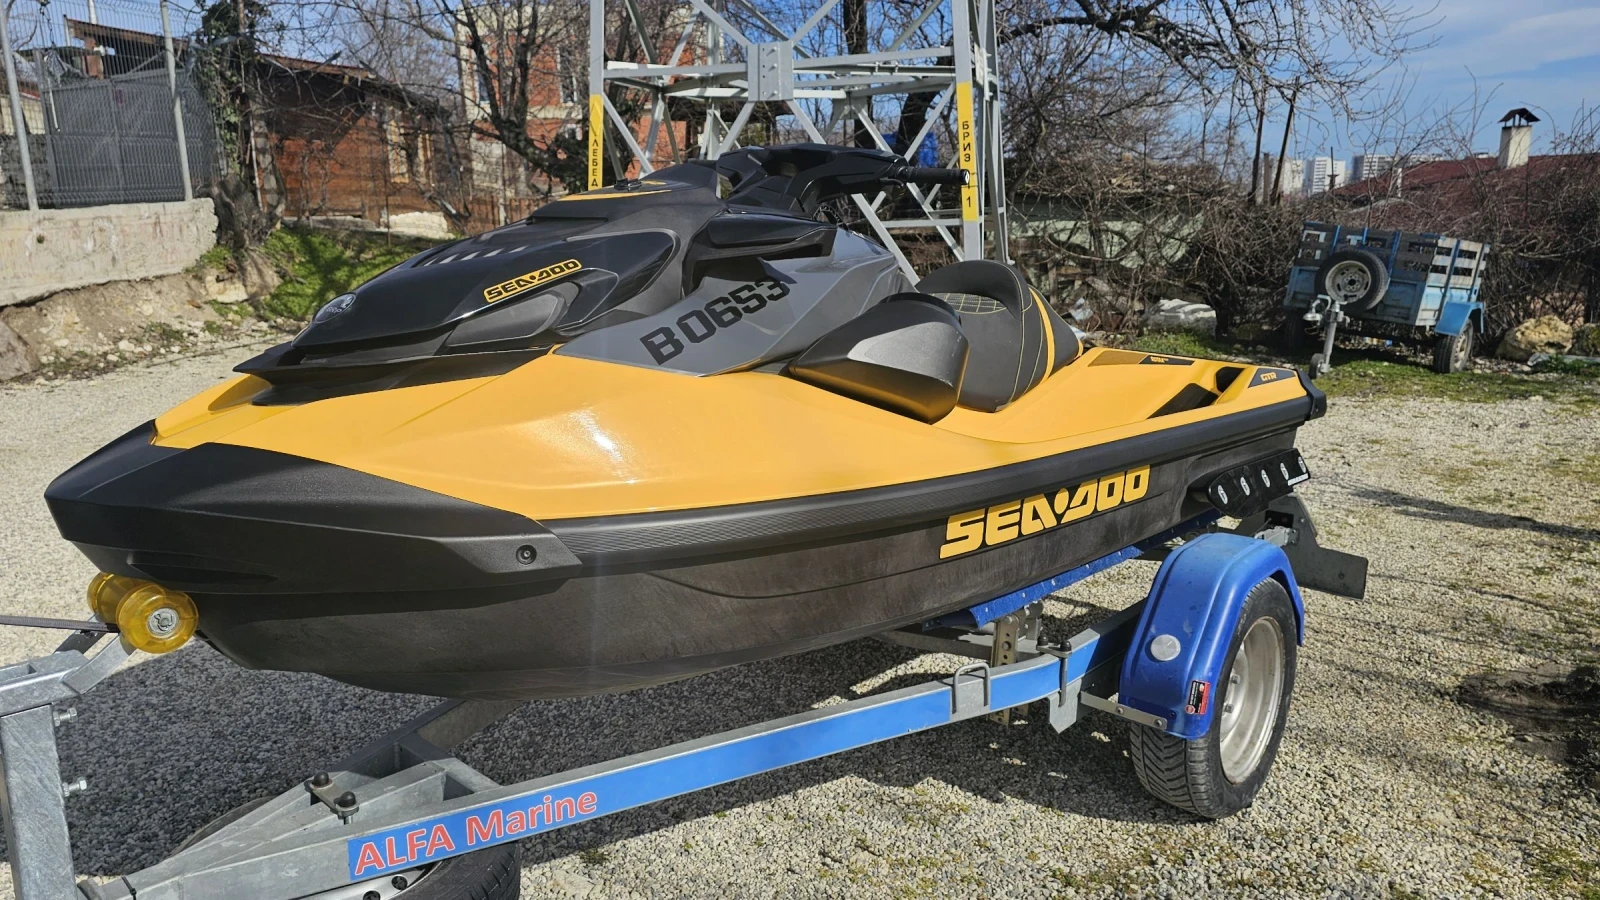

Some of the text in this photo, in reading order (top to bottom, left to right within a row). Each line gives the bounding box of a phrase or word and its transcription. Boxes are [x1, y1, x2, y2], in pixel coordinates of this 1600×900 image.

[962, 120, 971, 162] БРИЗ
[355, 792, 597, 876] ALFA Marine
